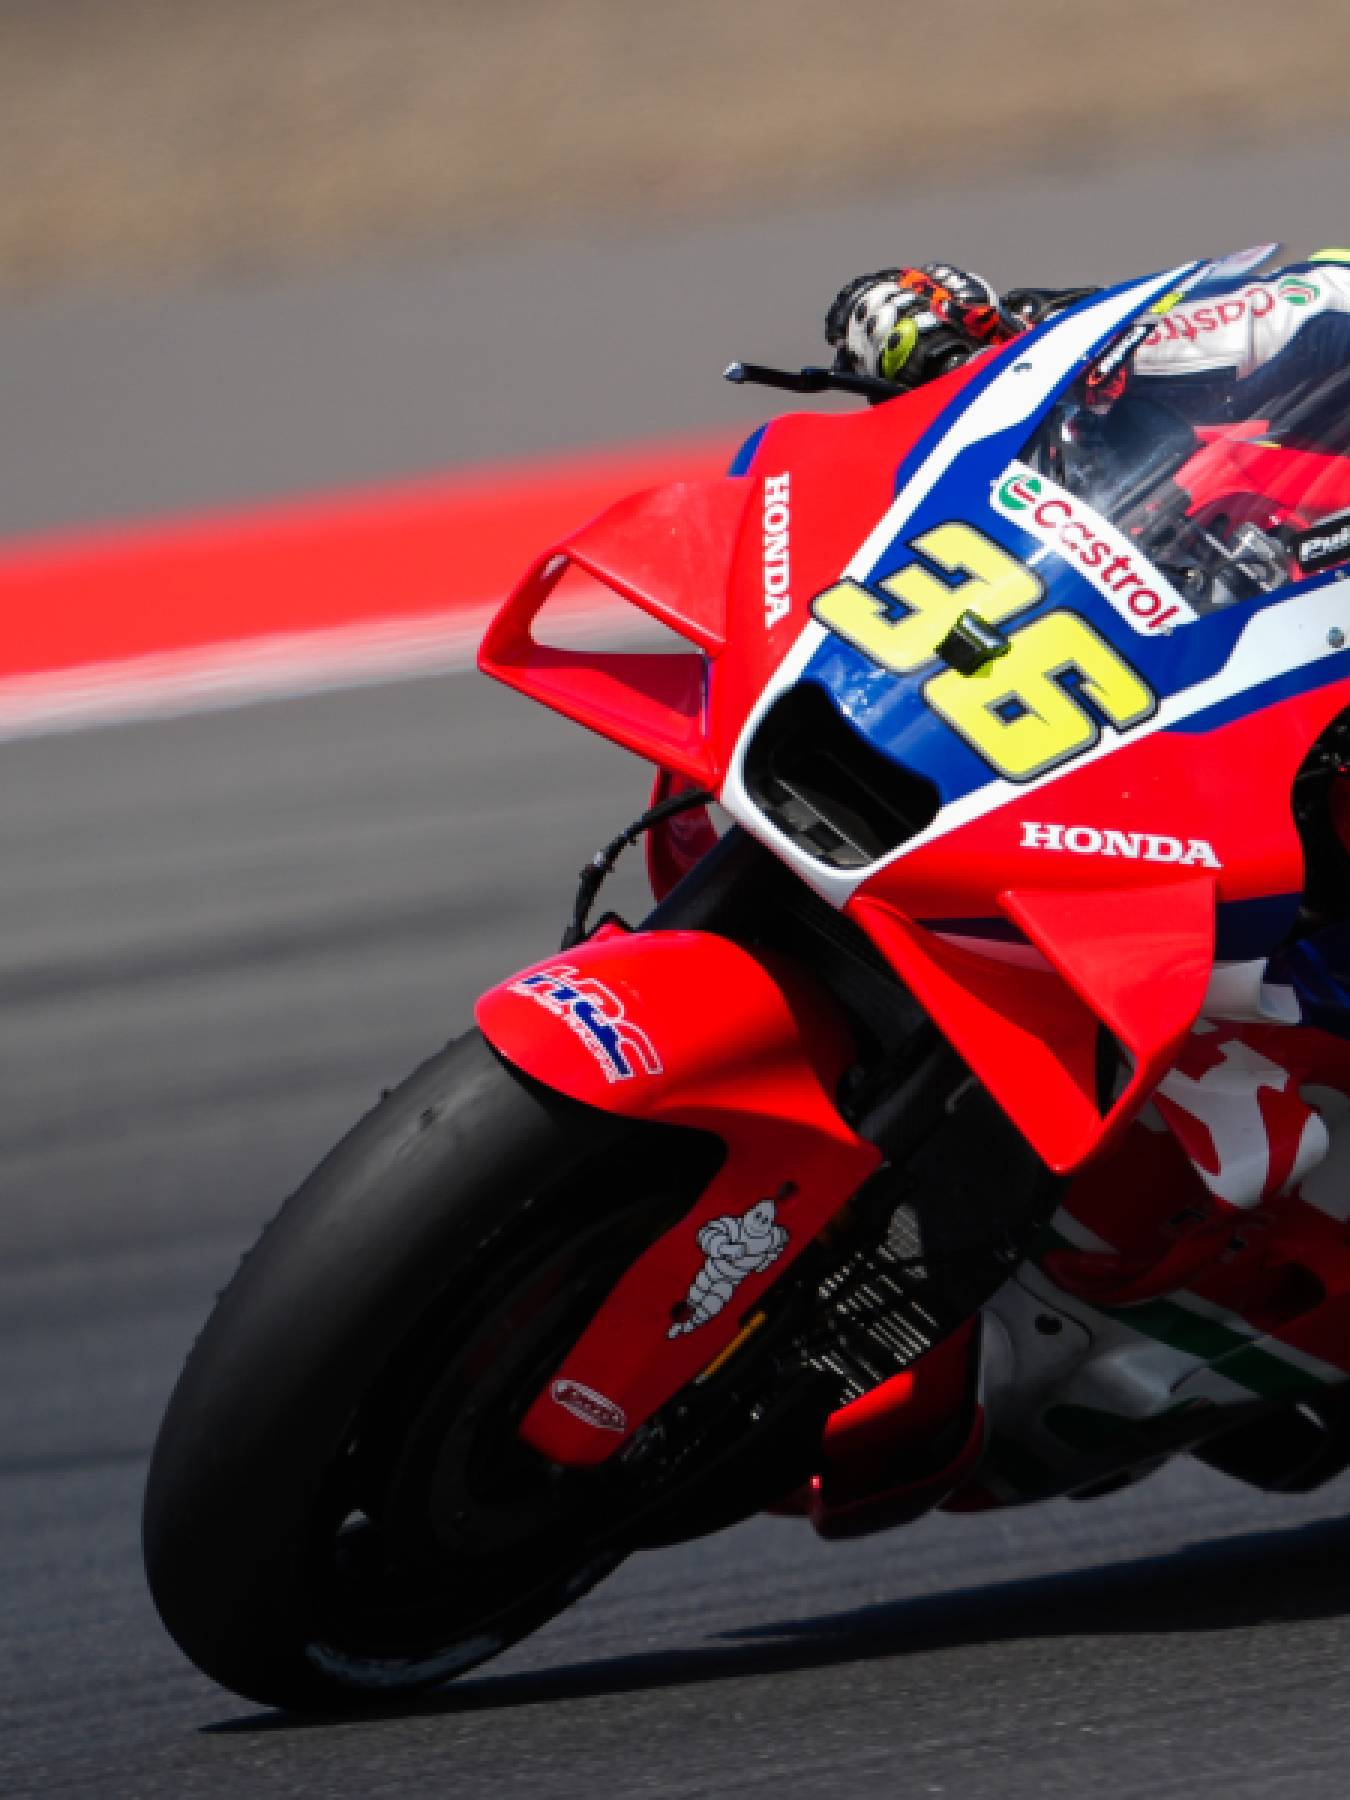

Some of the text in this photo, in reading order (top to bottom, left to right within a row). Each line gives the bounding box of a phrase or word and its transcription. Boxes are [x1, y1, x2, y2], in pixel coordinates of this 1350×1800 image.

[1143, 287, 1276, 346] Castro
[763, 471, 791, 630] HONDA
[1034, 499, 1180, 629] Castrol
[810, 518, 1160, 785] 36
[1020, 821, 1223, 869] HONDA
